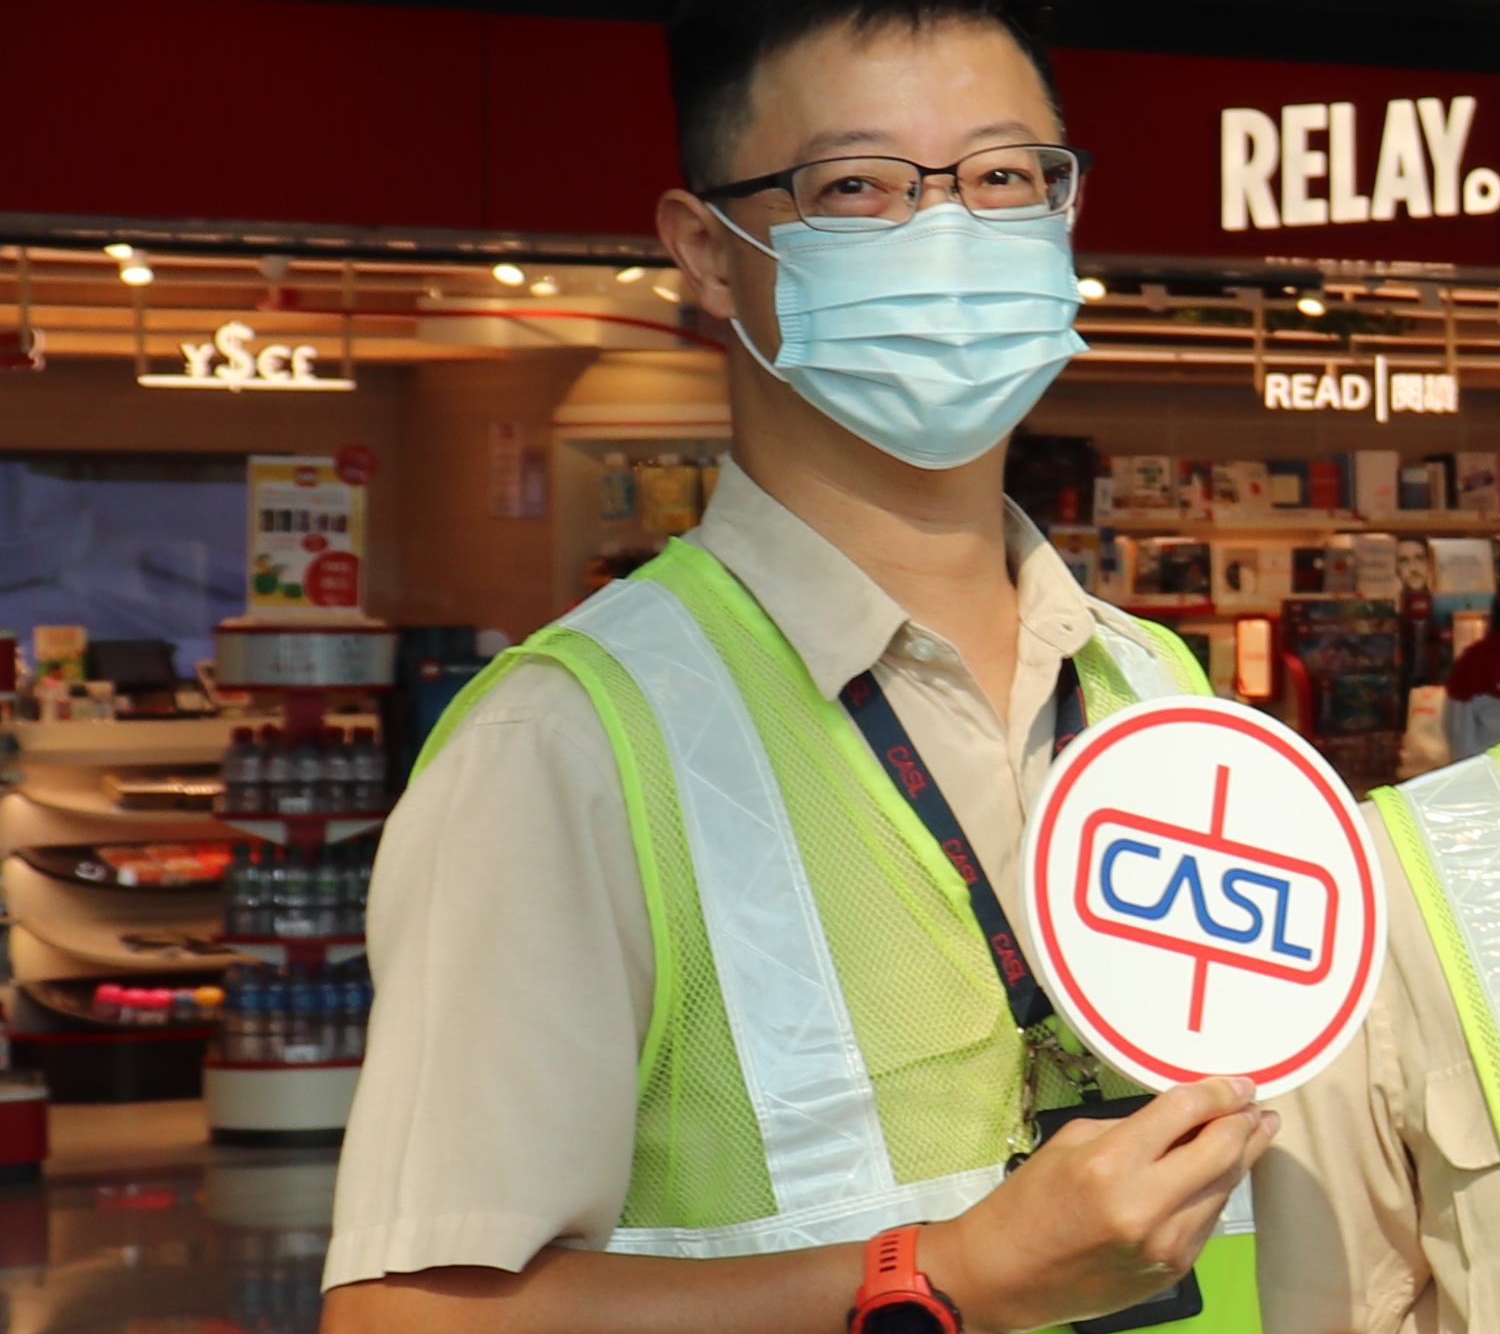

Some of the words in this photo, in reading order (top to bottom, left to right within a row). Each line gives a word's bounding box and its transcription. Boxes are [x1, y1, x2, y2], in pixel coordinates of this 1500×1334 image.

[1264, 373, 1372, 410] READ
[887, 745, 928, 798] CASL
[1099, 837, 1313, 962] CASL
[991, 933, 1027, 987] CASL
